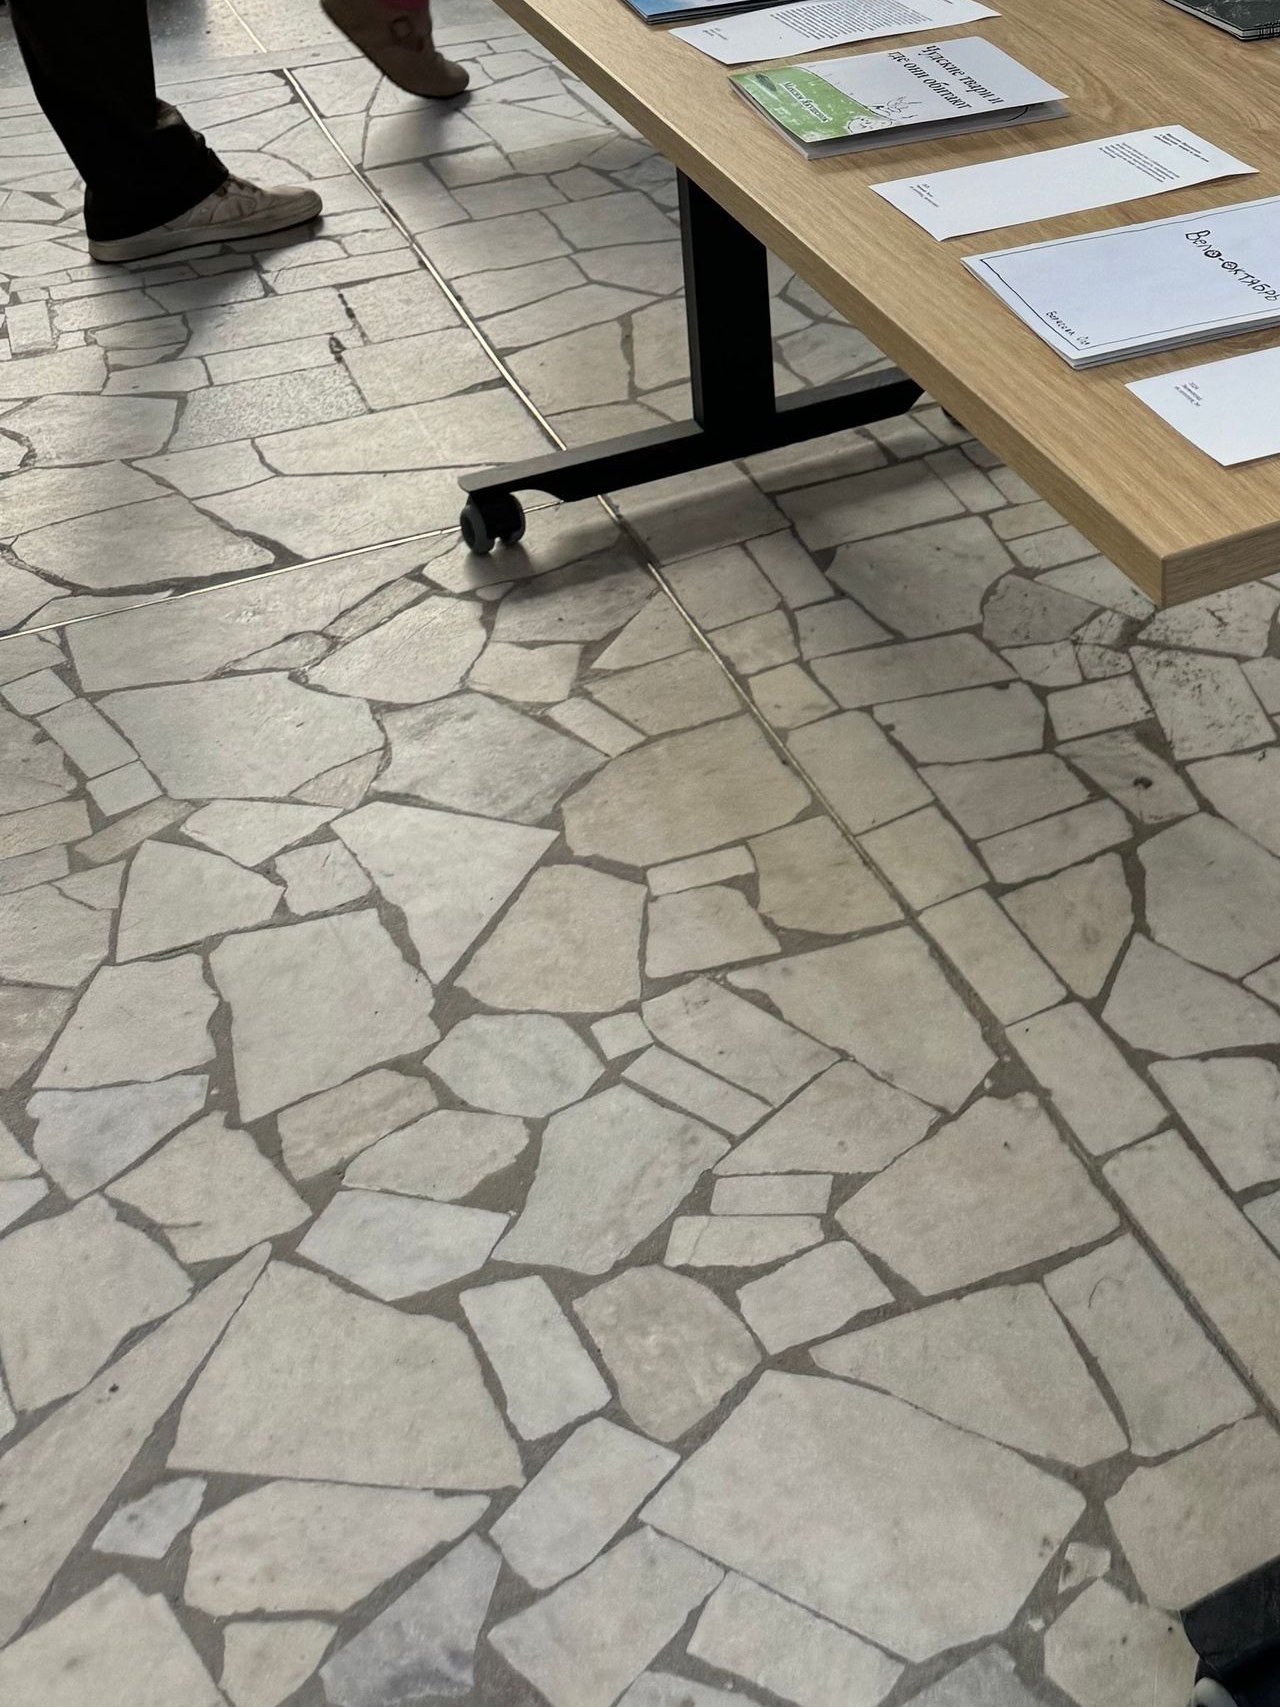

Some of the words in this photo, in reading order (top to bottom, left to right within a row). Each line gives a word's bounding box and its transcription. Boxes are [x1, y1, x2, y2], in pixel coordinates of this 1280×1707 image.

[888, 51, 910, 63] где
[903, 62, 930, 79] они
[923, 78, 972, 109] обитают
[918, 45, 965, 76] Чудские
[959, 75, 995, 98] твари
